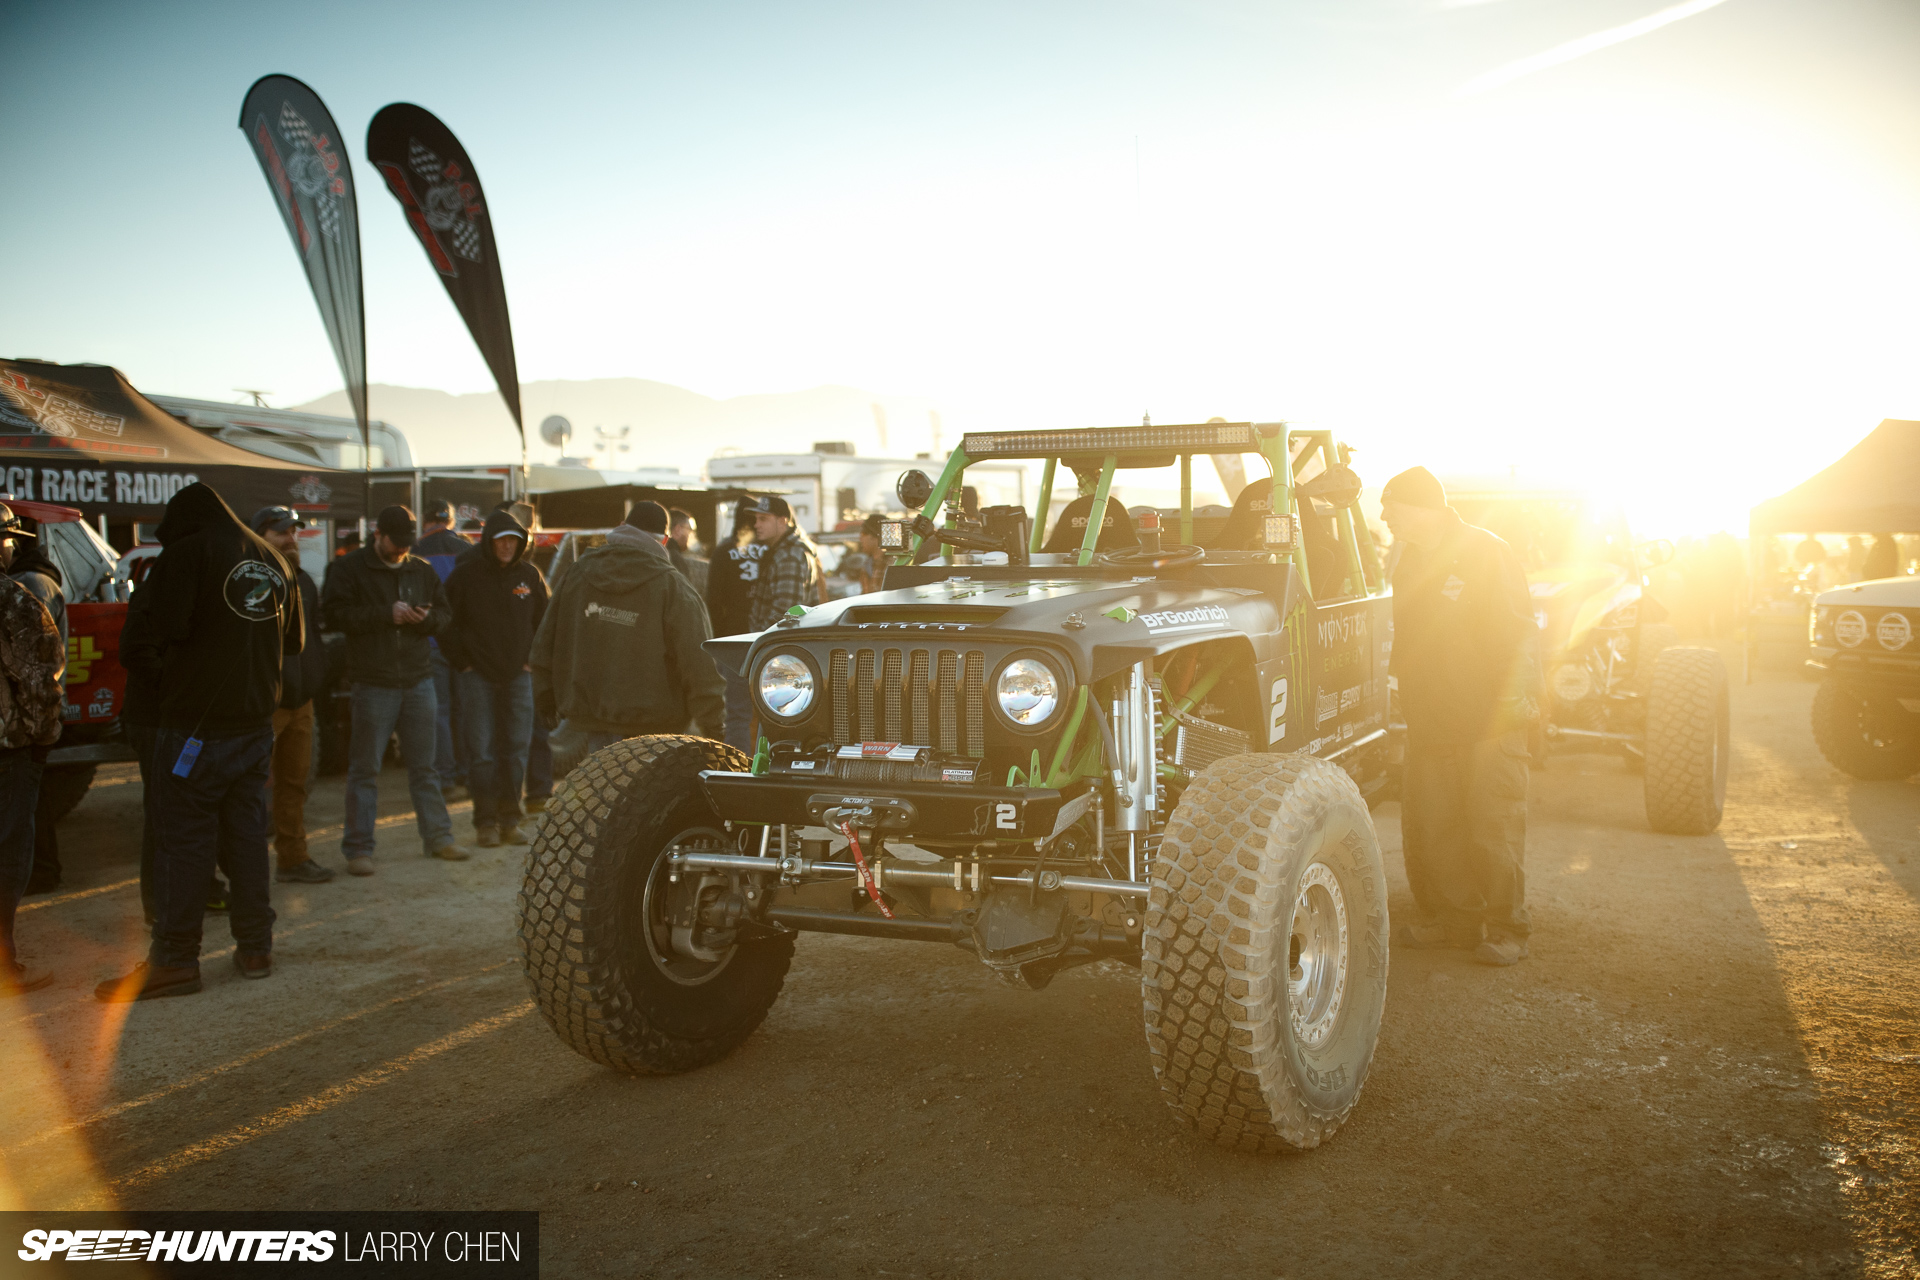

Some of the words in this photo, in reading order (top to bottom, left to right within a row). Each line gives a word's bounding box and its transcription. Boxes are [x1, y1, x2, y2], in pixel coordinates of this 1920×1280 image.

[41, 469, 109, 503] RACE
[858, 623, 966, 631] WHEELS
[1138, 604, 1229, 628] BFGoodrich
[1318, 611, 1367, 648] MONSTER
[1324, 645, 1364, 673] ENERGY
[1269, 677, 1287, 746] 2
[864, 744, 891, 752] WARN
[996, 803, 1017, 829] 2
[841, 821, 857, 844] WARN
[857, 860, 872, 883] WARN
[874, 898, 892, 918] WARN
